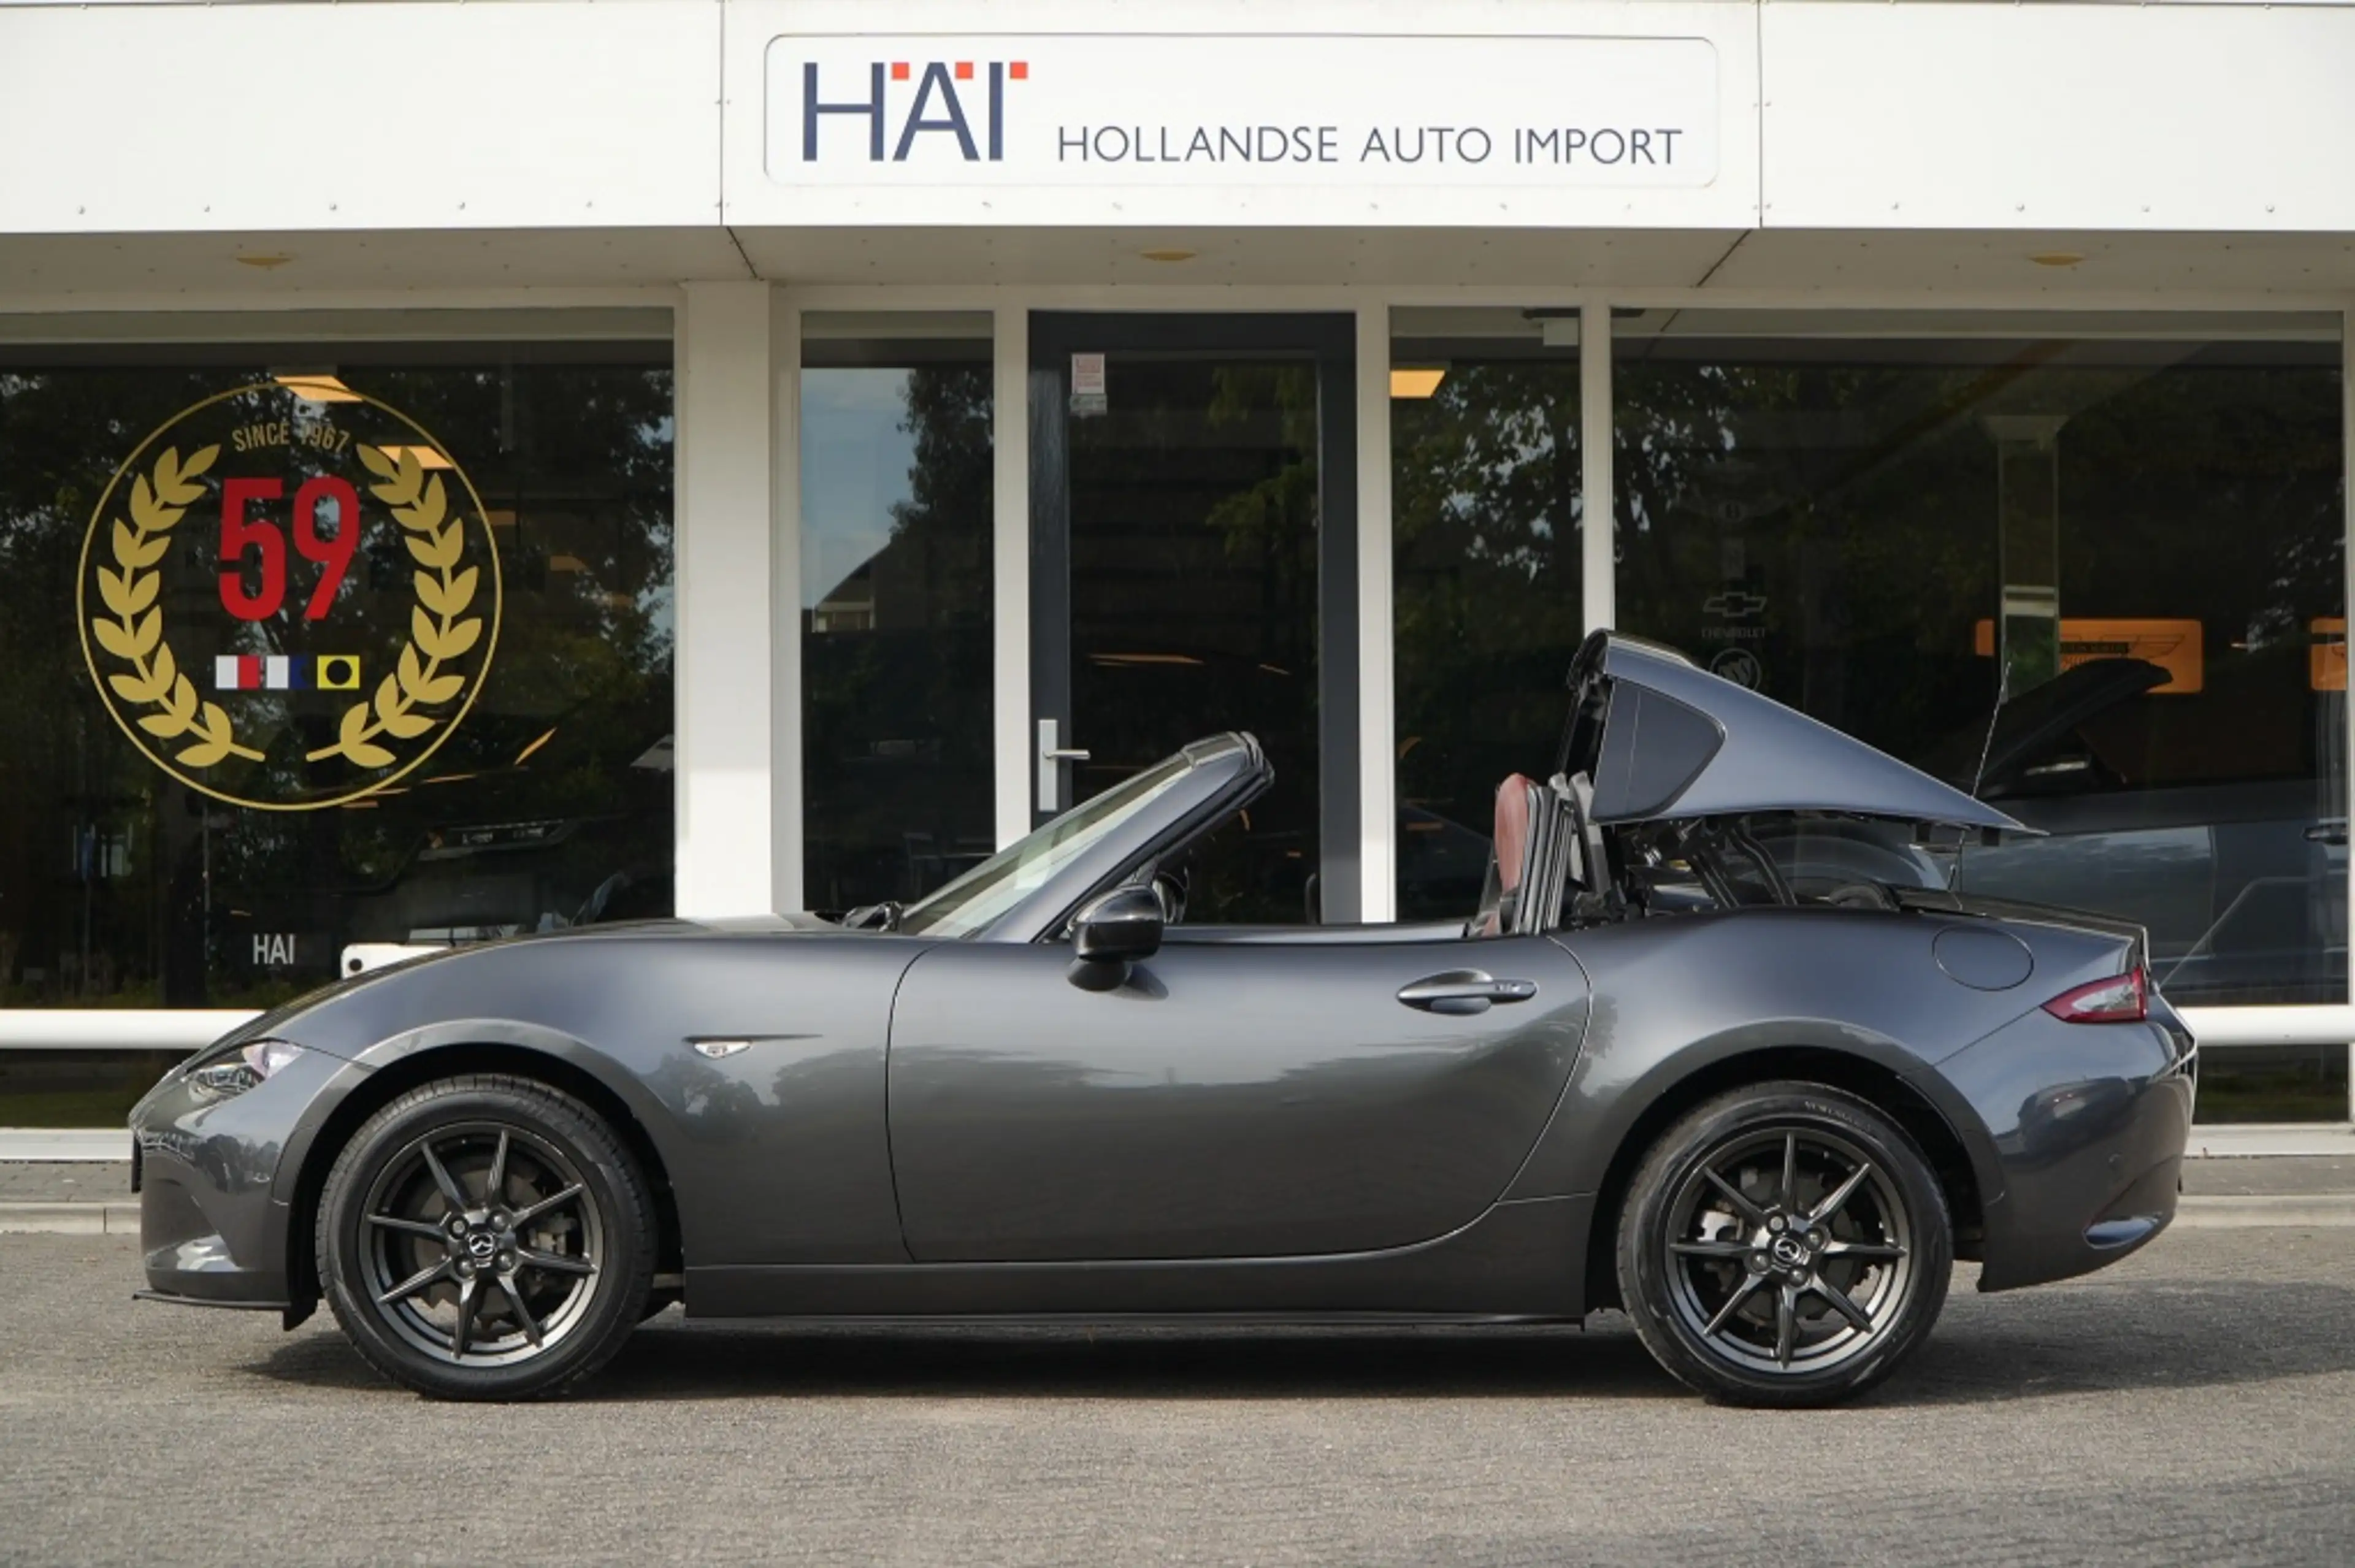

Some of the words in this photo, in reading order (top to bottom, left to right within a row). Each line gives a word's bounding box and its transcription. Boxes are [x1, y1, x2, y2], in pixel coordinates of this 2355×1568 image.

[1059, 126, 1339, 163] HOLLANDSE
[1360, 127, 1492, 164] AUTO
[1515, 128, 1683, 165] IMPORT
[232, 422, 291, 452] SINCE
[219, 476, 361, 621] 59
[253, 933, 295, 965] HAI
